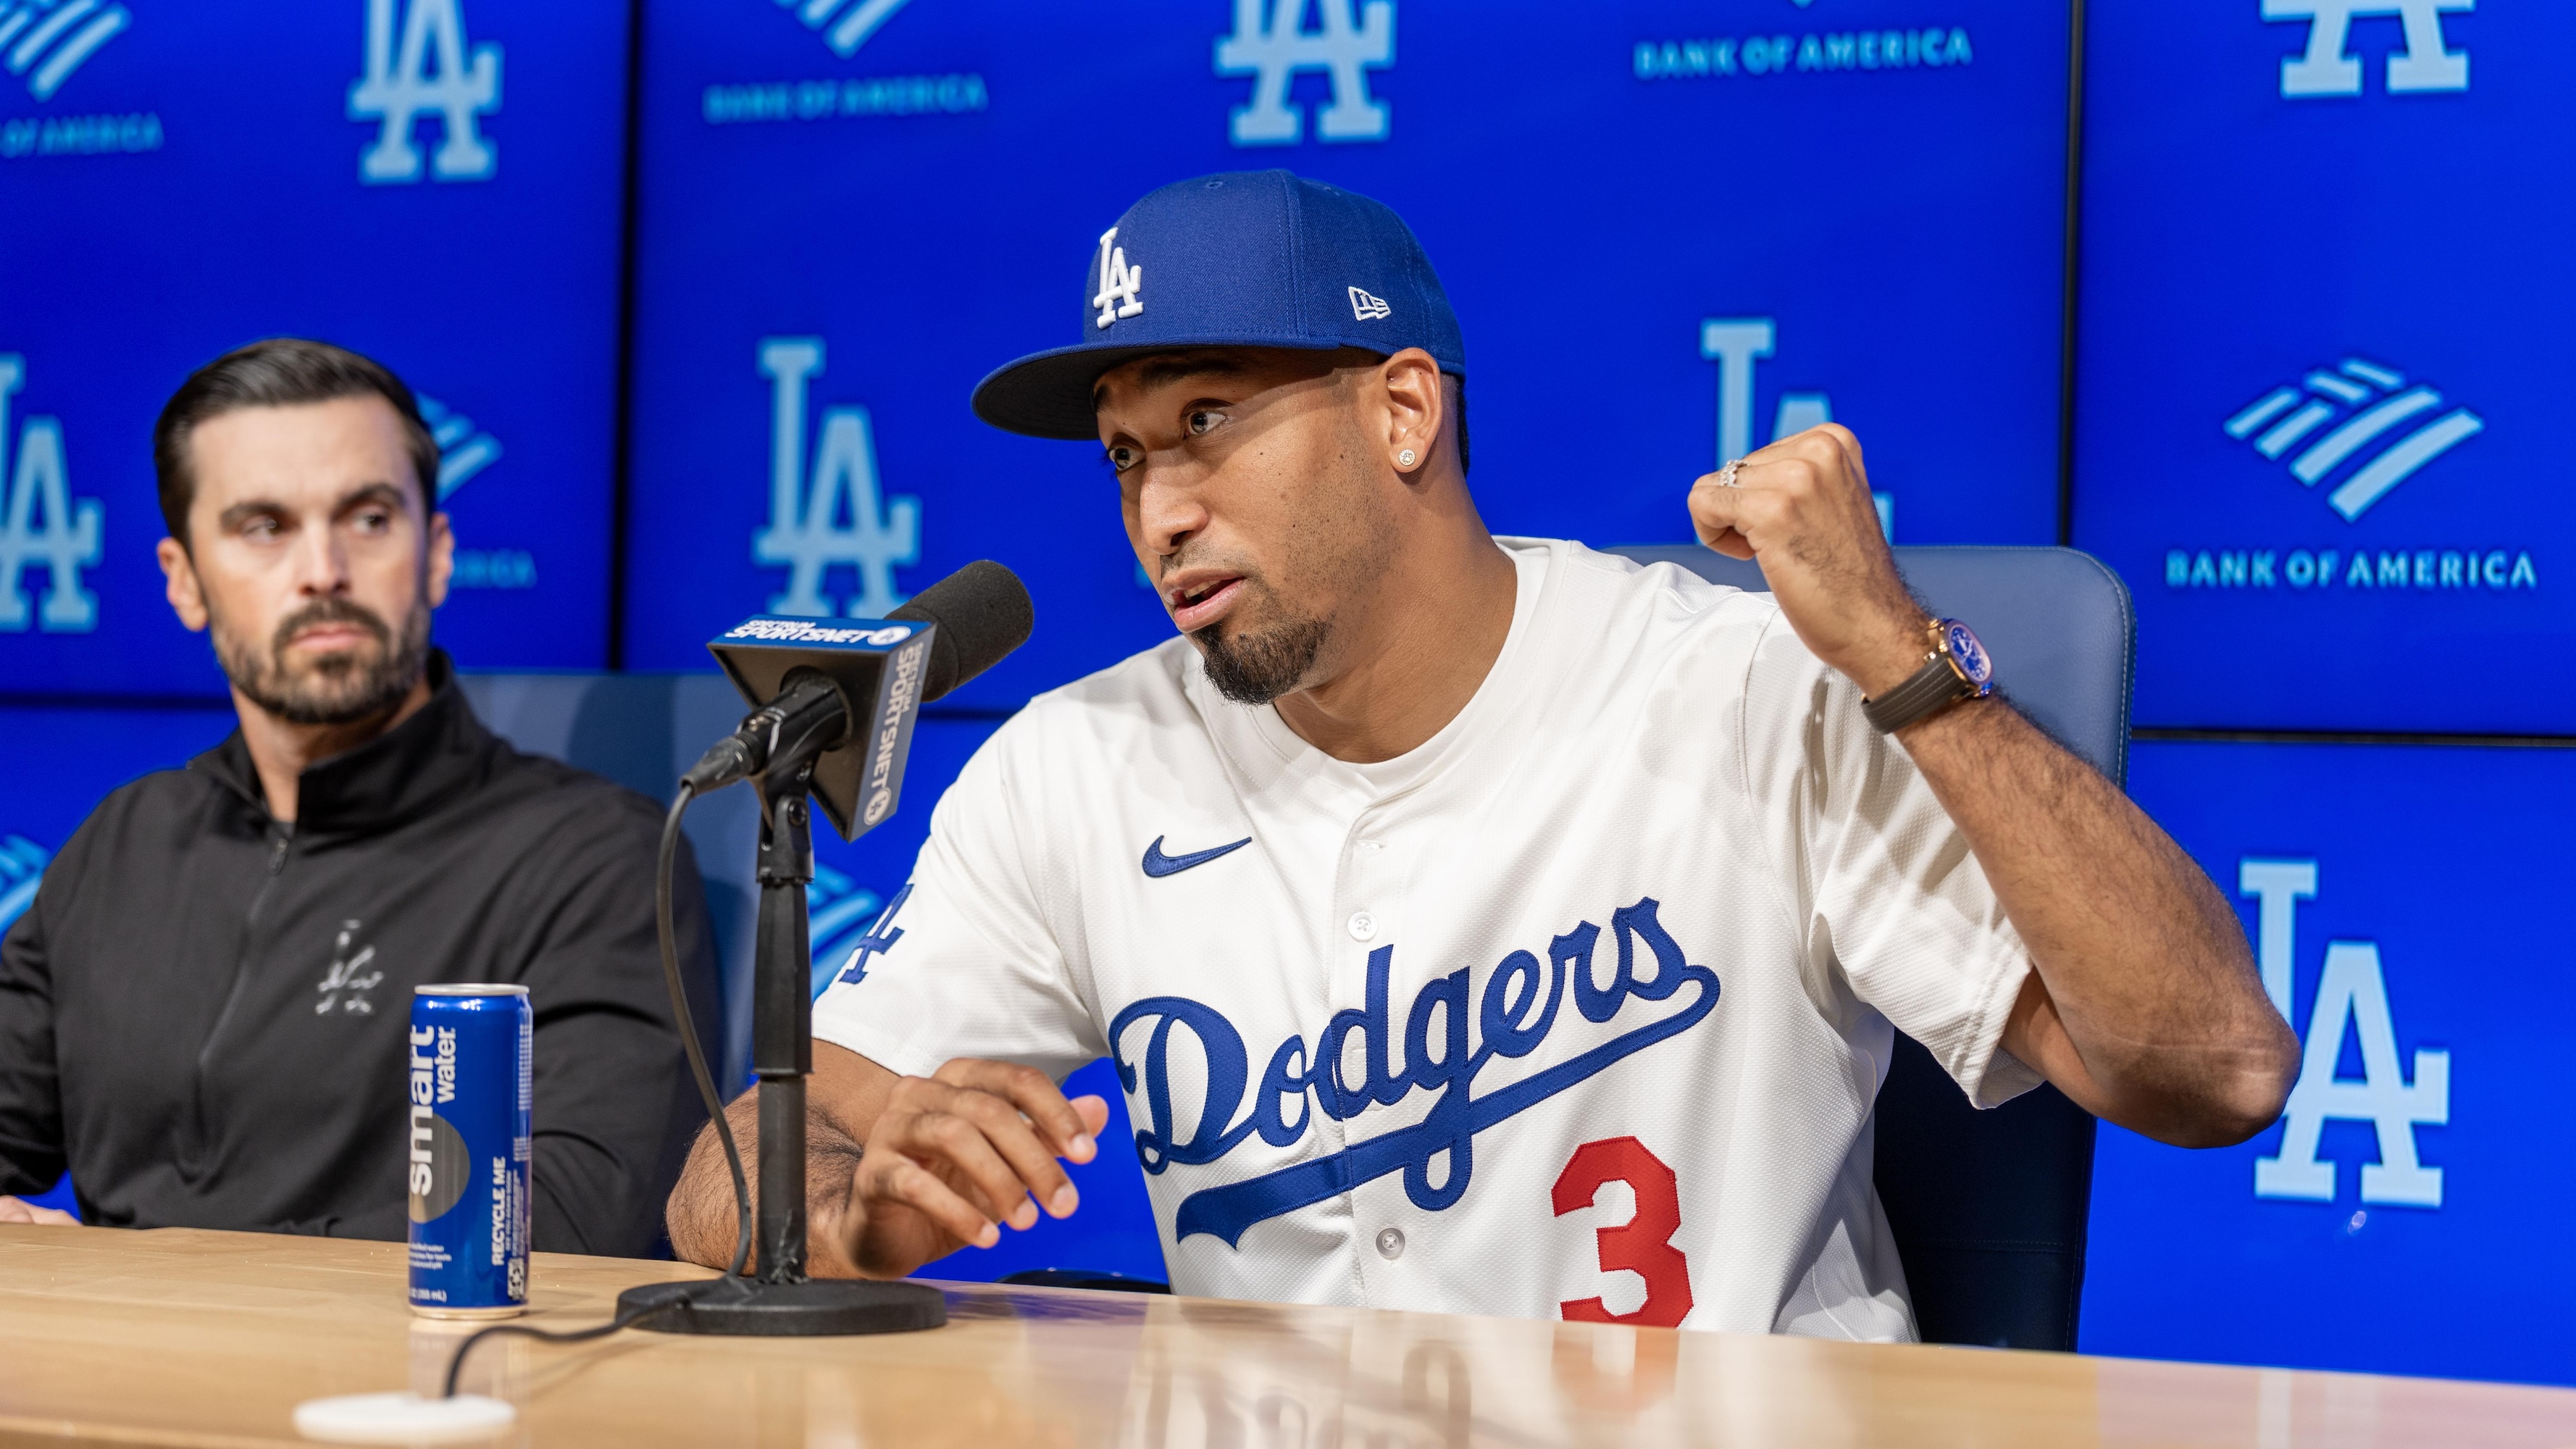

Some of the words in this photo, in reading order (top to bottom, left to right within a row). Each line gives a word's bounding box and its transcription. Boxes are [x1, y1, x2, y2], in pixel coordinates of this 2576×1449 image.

[1633, 39, 1737, 80] BANK
[1741, 35, 1795, 75] OF
[1796, 26, 1973, 72] AMERICA
[1093, 226, 1143, 329] LA
[752, 336, 923, 617] LA
[1699, 317, 1895, 545] L
[2166, 548, 2276, 588] BANK
[2284, 548, 2340, 588] OF
[2346, 548, 2536, 588] AMERICA
[725, 625, 875, 643] SPORTSNET
[903, 641, 924, 714] SPECTRUM
[871, 645, 914, 788] SPORTSNET
[837, 883, 915, 985] A
[435, 1025, 456, 1103] water
[1109, 897, 1721, 1214] Dodgers
[2240, 857, 2451, 1207] LA
[410, 1024, 435, 1196] smart
[493, 1156, 506, 1185] ME
[492, 1187, 506, 1266] RECYCLE
[1551, 1135, 1694, 1329] 3
